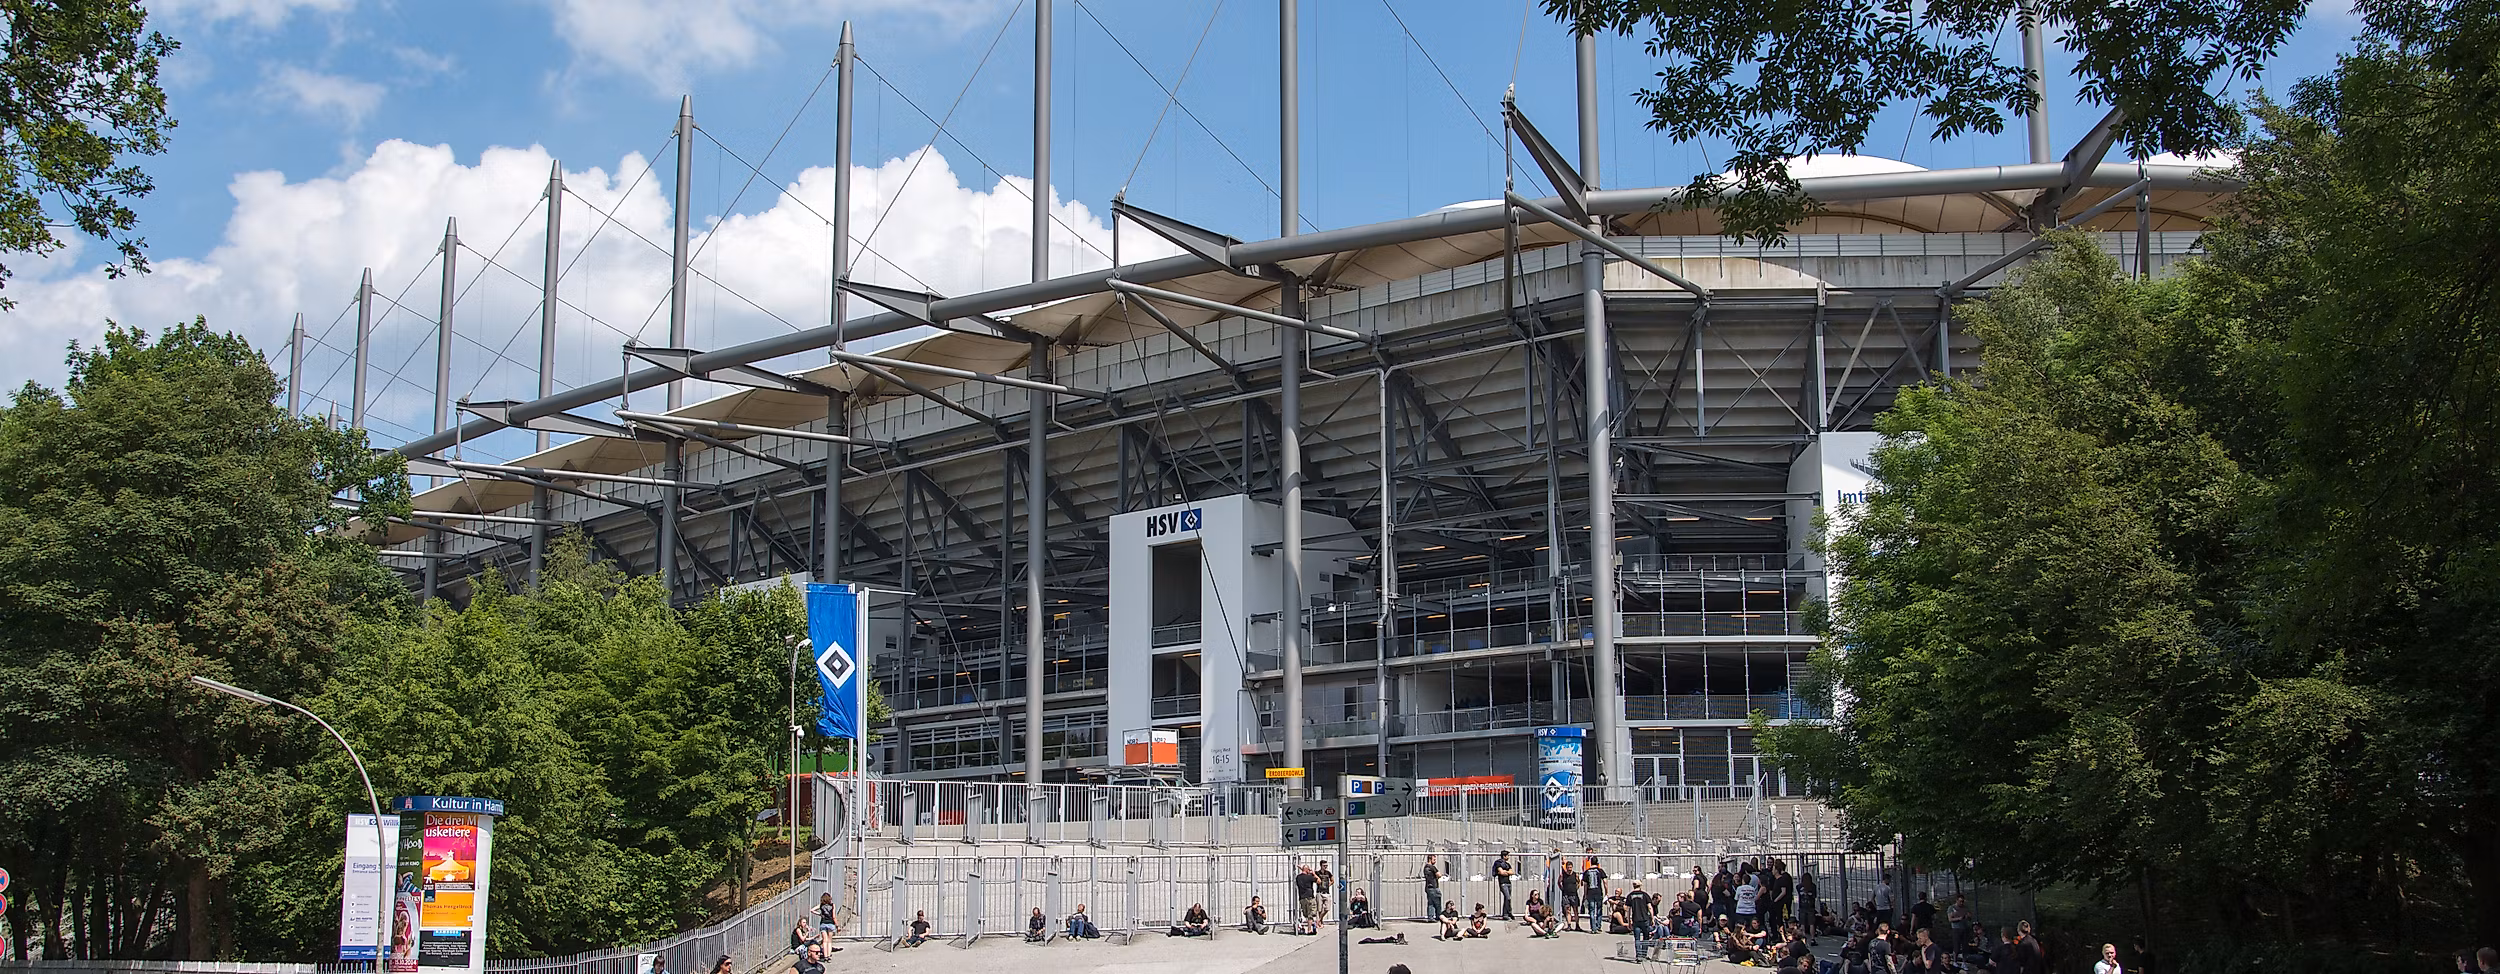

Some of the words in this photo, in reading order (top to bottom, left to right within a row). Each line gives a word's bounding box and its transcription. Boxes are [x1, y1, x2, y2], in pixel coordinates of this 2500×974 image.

[1147, 512, 1179, 537] HSV
[1538, 728, 1548, 737] HSV
[1212, 754, 1230, 764] 16-15
[1353, 781, 1361, 793] P
[1376, 782, 1383, 793] P
[432, 797, 469, 809] Kultur
[472, 799, 482, 810] in
[1350, 803, 1356, 813] P
[426, 815, 443, 826] Die
[444, 814, 464, 826] drei
[467, 815, 477, 826] M
[425, 826, 471, 838] usketiere
[1301, 829, 1307, 840] P
[1320, 828, 1326, 839] P
[352, 862, 377, 871] Eingang
